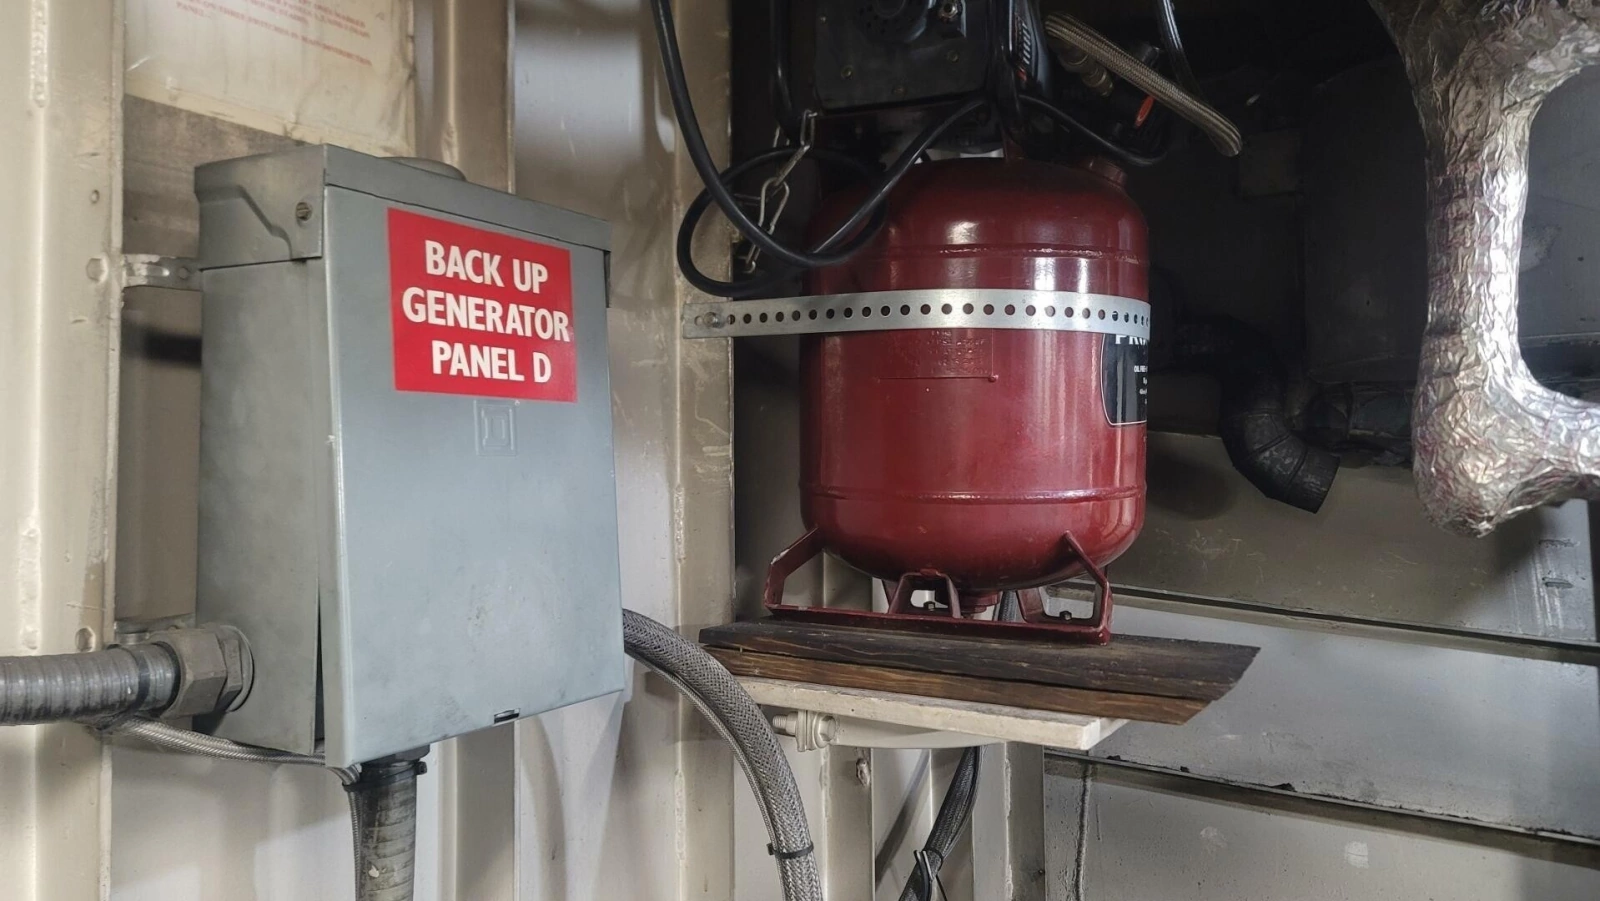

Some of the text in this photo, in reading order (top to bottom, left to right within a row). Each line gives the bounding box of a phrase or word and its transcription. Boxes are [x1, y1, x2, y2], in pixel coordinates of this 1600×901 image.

[425, 240, 548, 294] BACK UP
[402, 286, 570, 342] GENERATOR
[431, 340, 552, 383] PANEL D
